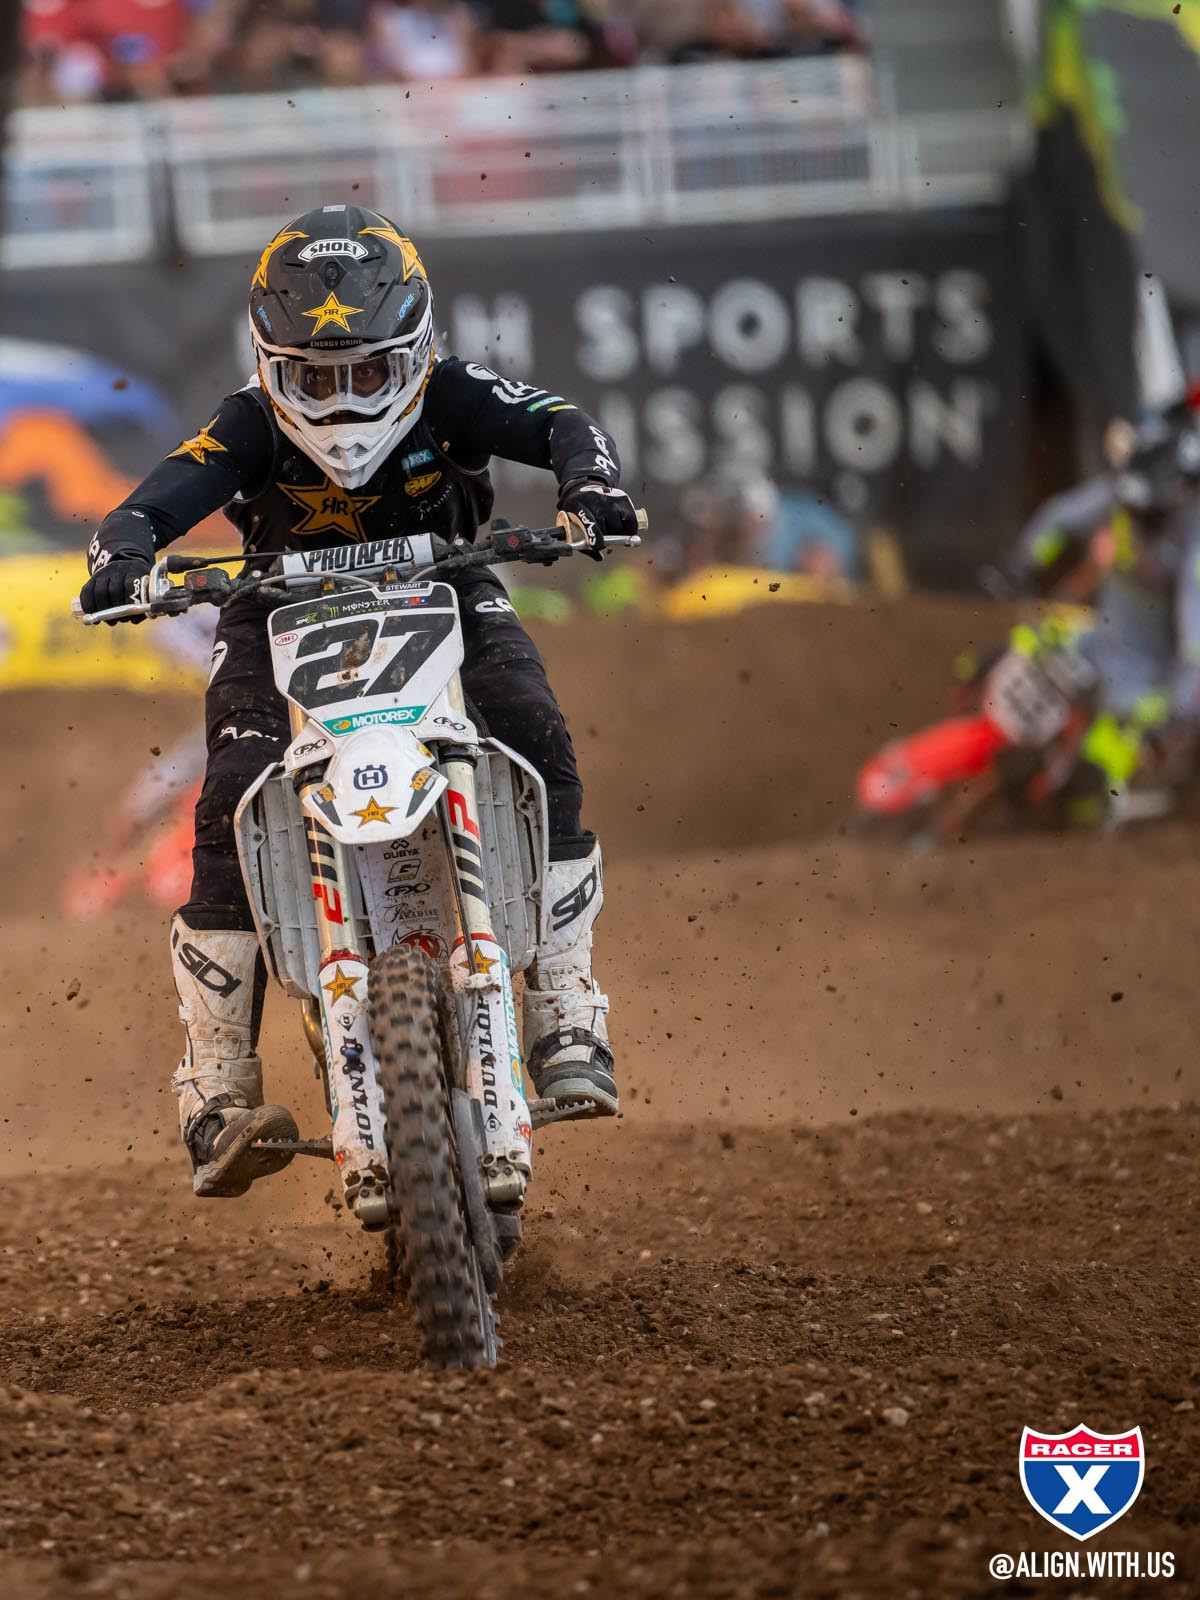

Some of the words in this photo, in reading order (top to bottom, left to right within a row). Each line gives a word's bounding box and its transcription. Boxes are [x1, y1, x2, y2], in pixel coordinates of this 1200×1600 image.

[310, 241, 358, 256] SHOEI
[575, 270, 992, 382] SPORTS
[307, 536, 407, 573] PROTAPER
[385, 582, 422, 591] STEWART
[342, 599, 390, 612] MONSTER
[287, 612, 456, 711] 27
[352, 708, 416, 728] MOTOREX
[384, 848, 420, 860] DUBYA
